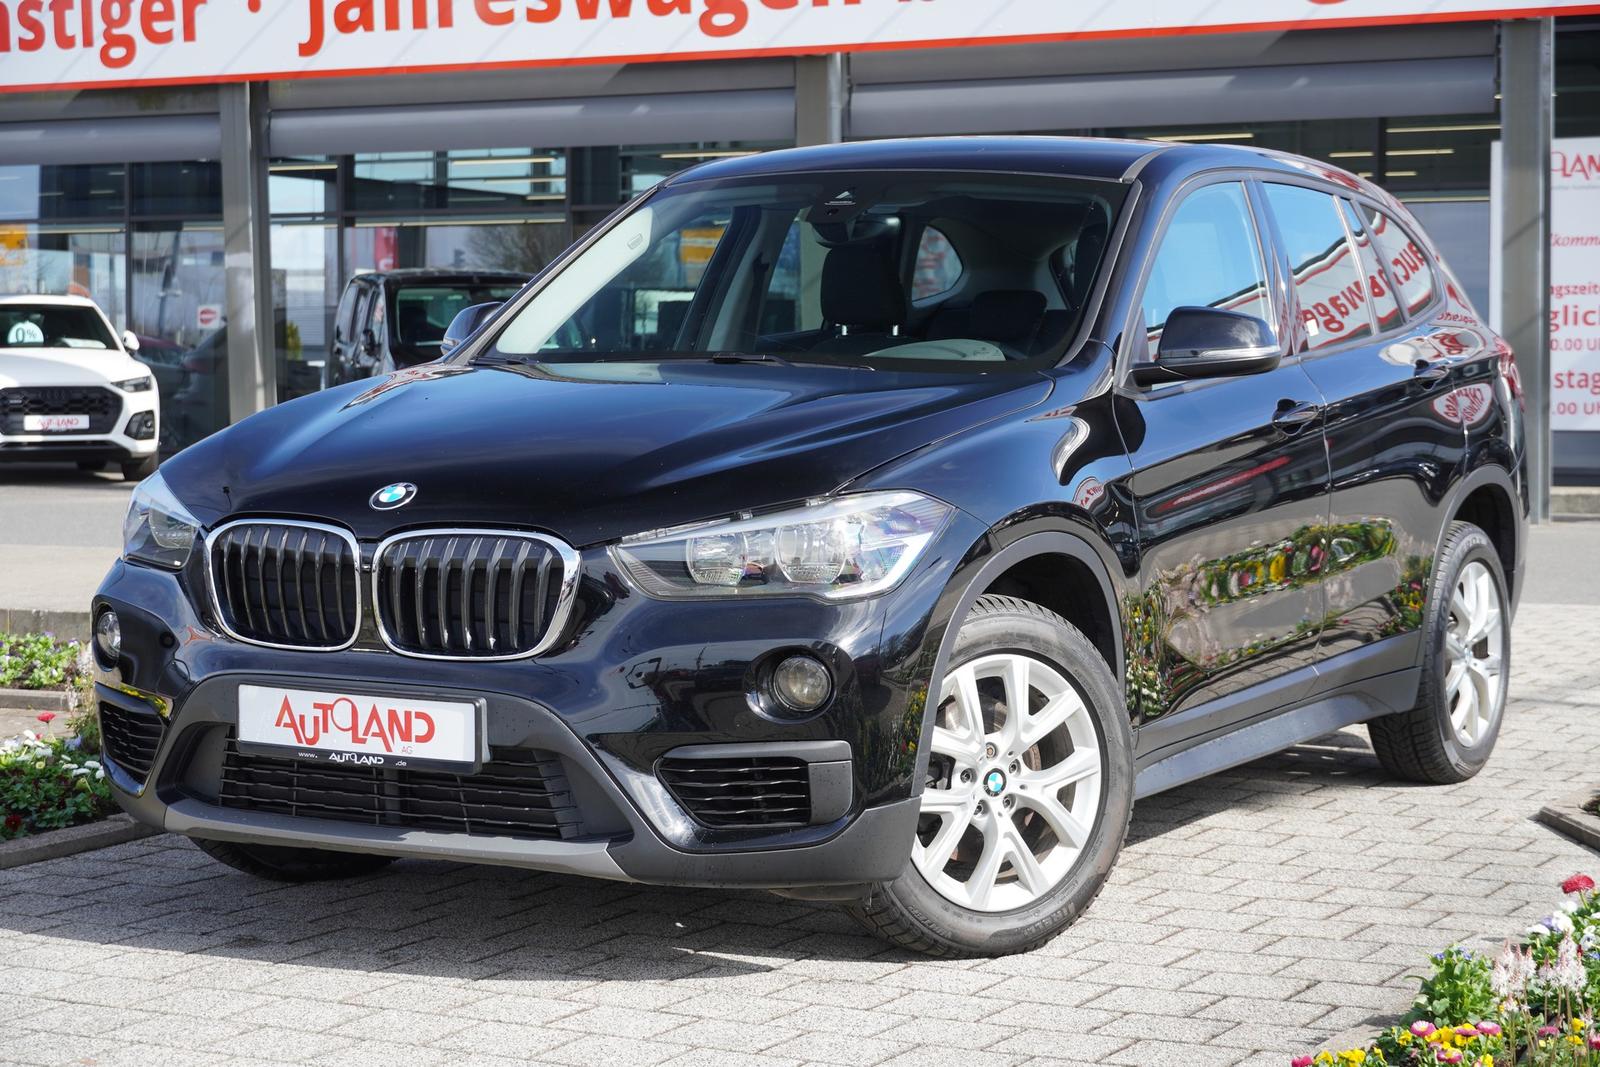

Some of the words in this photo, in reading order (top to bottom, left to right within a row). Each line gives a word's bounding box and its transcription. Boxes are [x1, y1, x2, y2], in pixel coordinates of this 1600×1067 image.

[1550, 233, 1600, 247] komm
[1550, 282, 1600, 299] gszeit
[1550, 304, 1600, 333] glic
[1586, 338, 1600, 351] U
